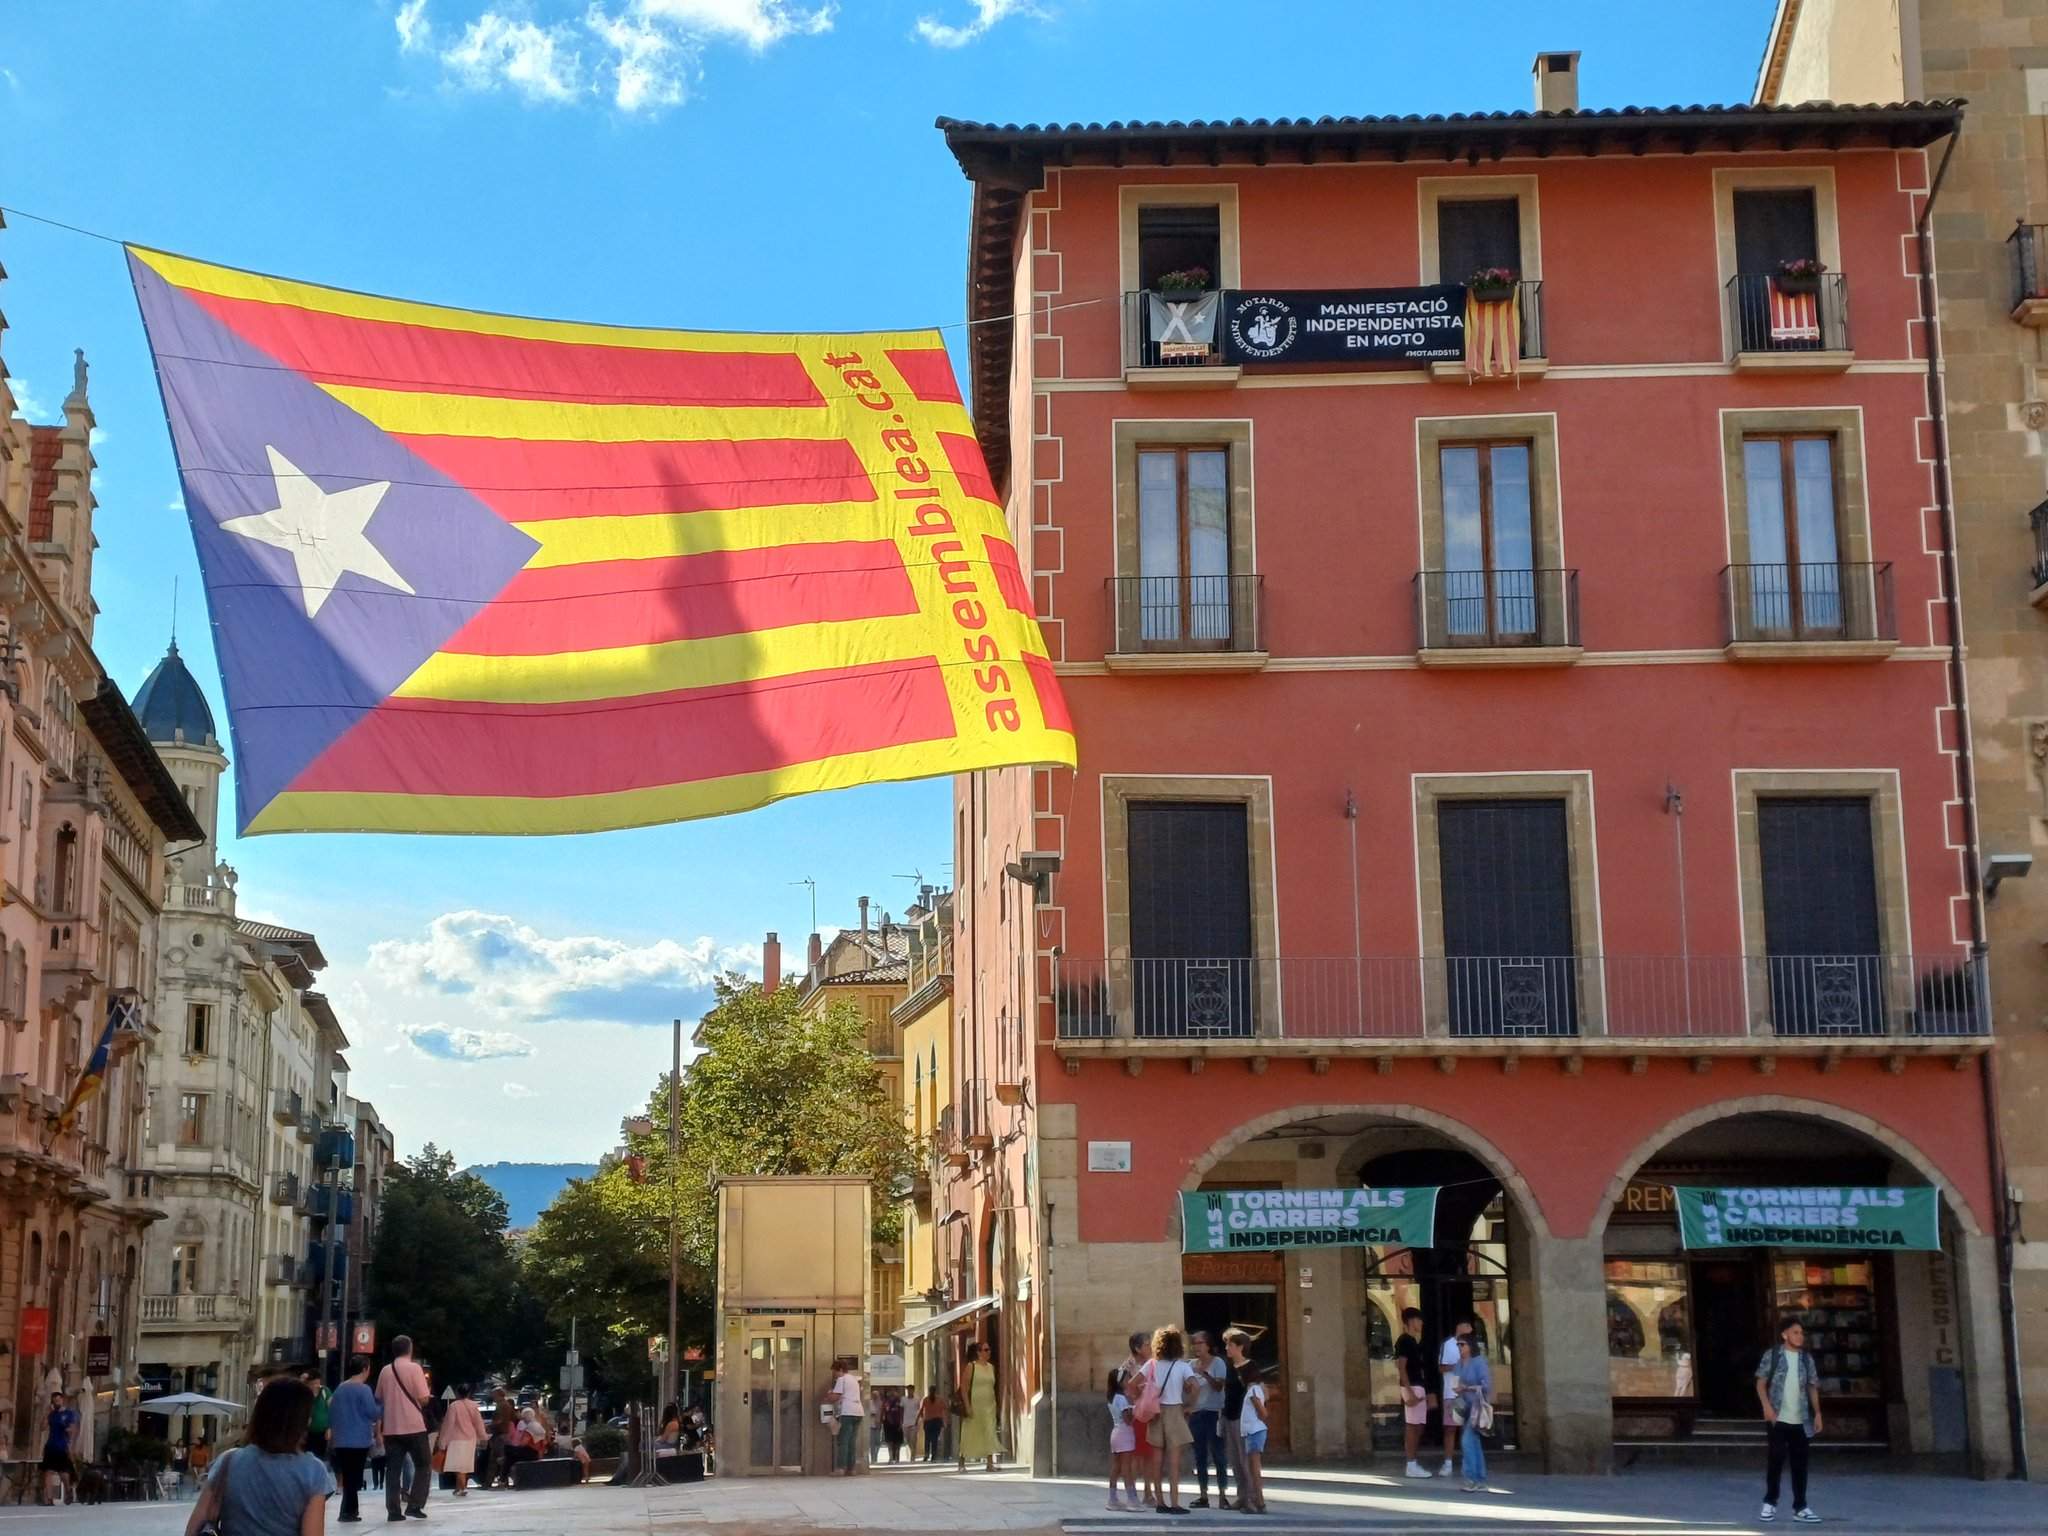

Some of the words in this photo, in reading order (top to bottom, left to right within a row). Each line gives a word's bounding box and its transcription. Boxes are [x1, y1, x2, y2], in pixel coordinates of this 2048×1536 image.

[1236, 297, 1291, 315] MOTARDS
[1320, 297, 1449, 316] MANIFESTACIÓ
[1306, 315, 1464, 332] INDEPENDENTISTA
[1346, 335, 1369, 347] EN
[1374, 332, 1425, 346] MOTO
[823, 351, 1020, 733] assemblea.cat
[1226, 1191, 1343, 1210] TORNEM
[1350, 1190, 1405, 1208] ALS
[1720, 1189, 1841, 1206] TORNEM
[1847, 1189, 1905, 1206] ALS
[1228, 1208, 1360, 1228] CARRERS
[1724, 1207, 1858, 1226] CARRERS
[1229, 1227, 1402, 1247] INDEPENDÈNCIA
[1727, 1226, 1906, 1245] INDEPENDÈNCIA
